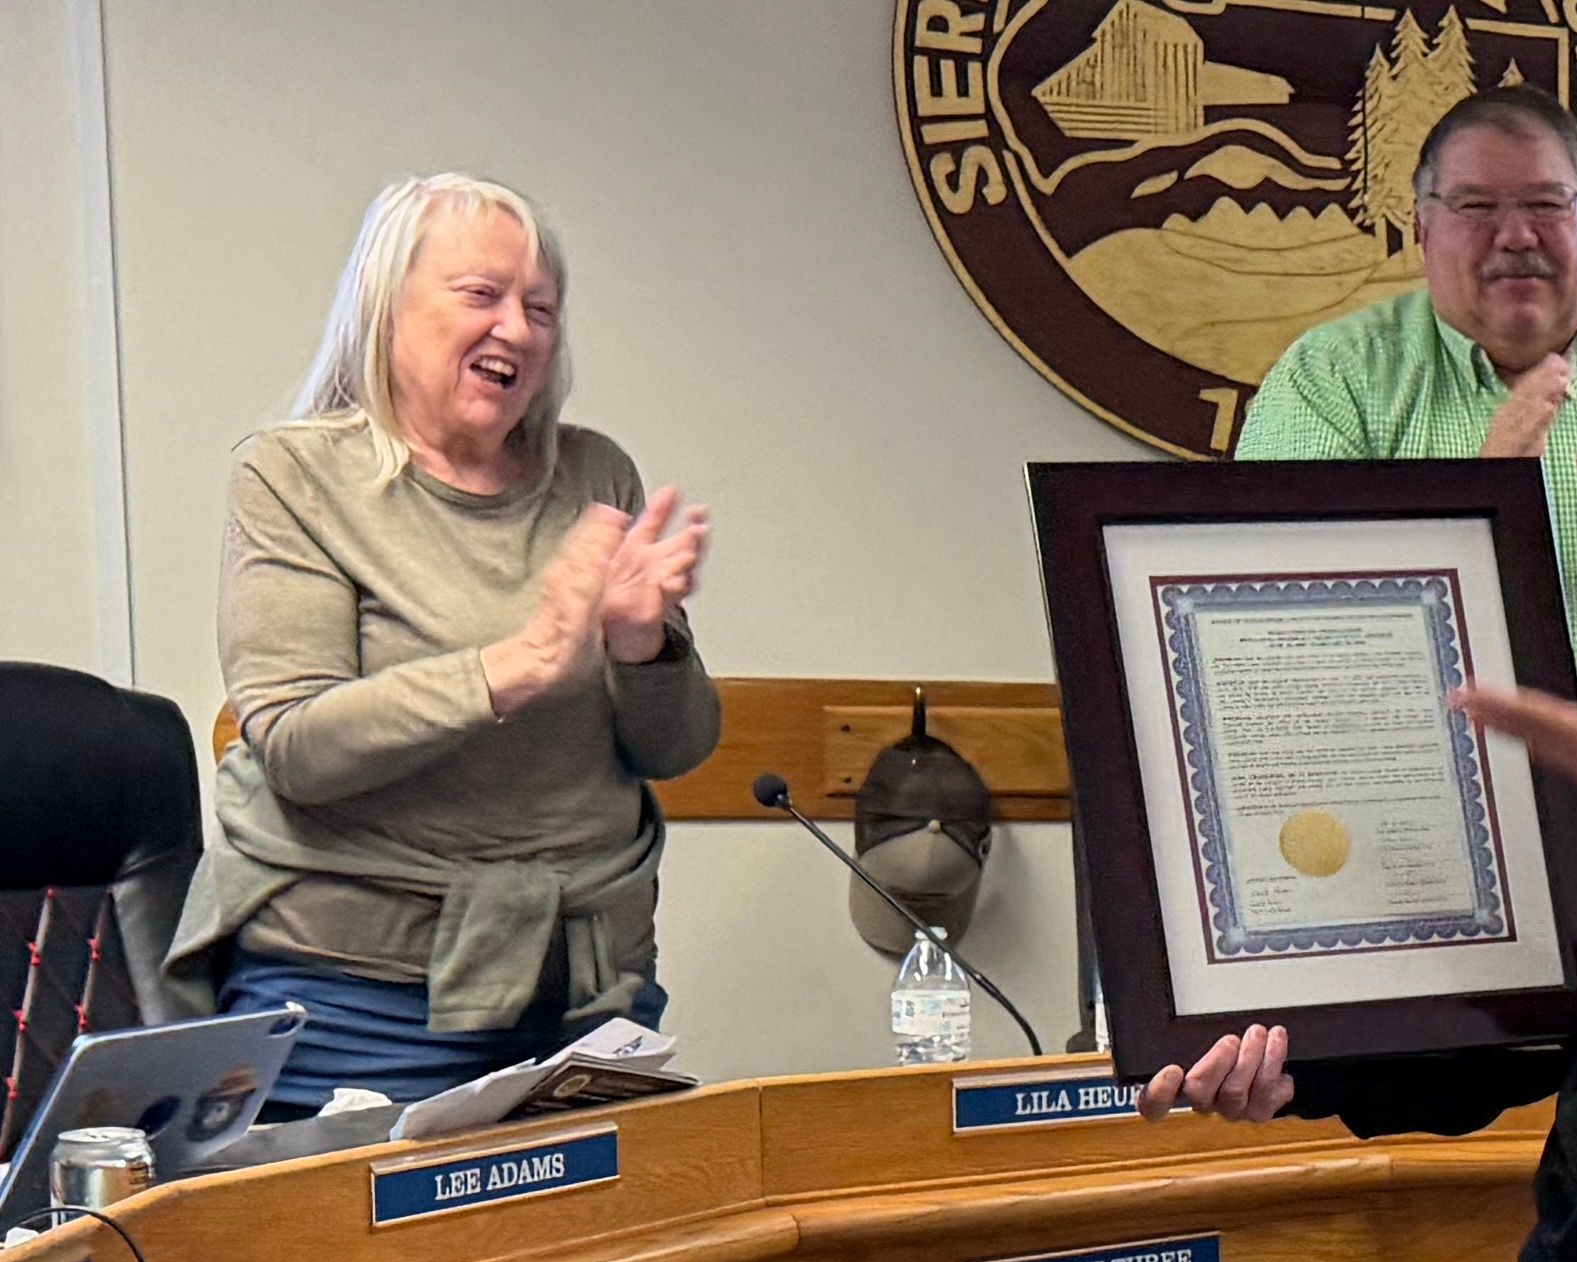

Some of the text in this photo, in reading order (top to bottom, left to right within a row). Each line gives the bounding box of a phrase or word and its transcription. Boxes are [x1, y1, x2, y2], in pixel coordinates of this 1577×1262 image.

[914, 0, 1008, 215] SIER
[1015, 1089, 1073, 1115] LILA
[434, 1153, 565, 1201] LEE ADAMS
